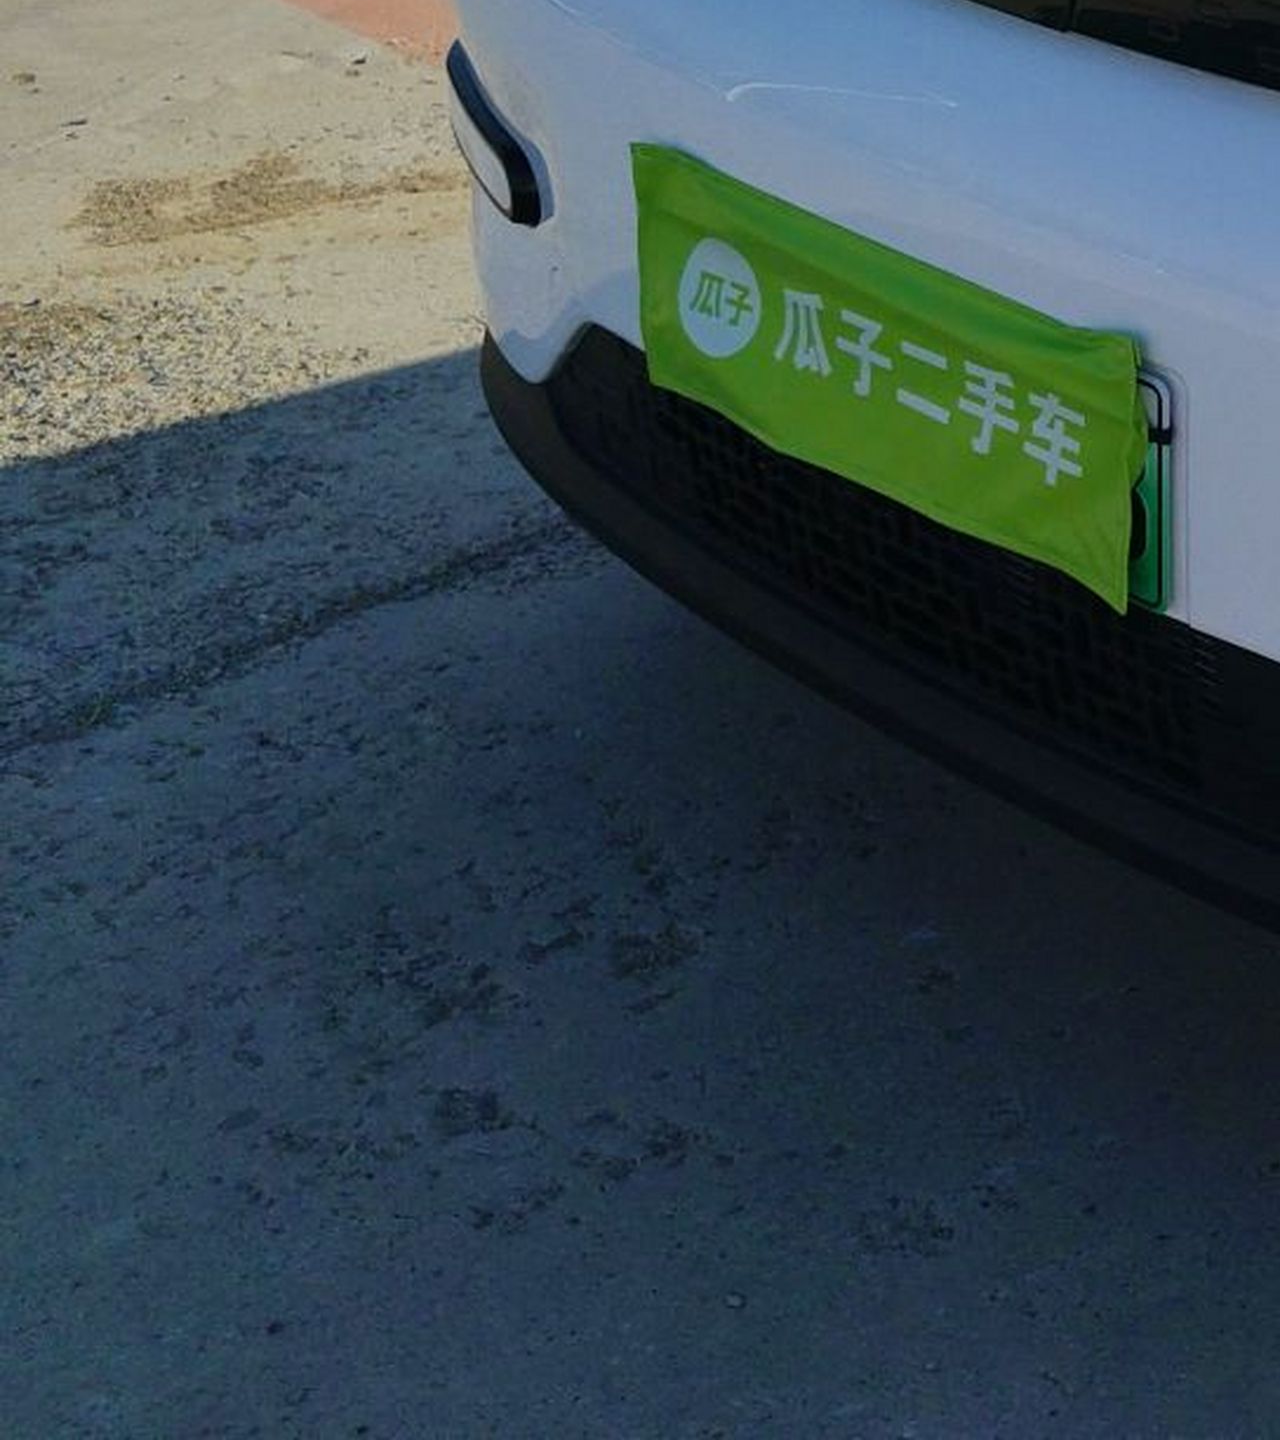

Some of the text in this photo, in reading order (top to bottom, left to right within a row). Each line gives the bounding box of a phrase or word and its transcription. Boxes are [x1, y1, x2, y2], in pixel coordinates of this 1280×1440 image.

[688, 270, 754, 328] 瓜子
[774, 288, 1086, 487] 瓜子二手车
